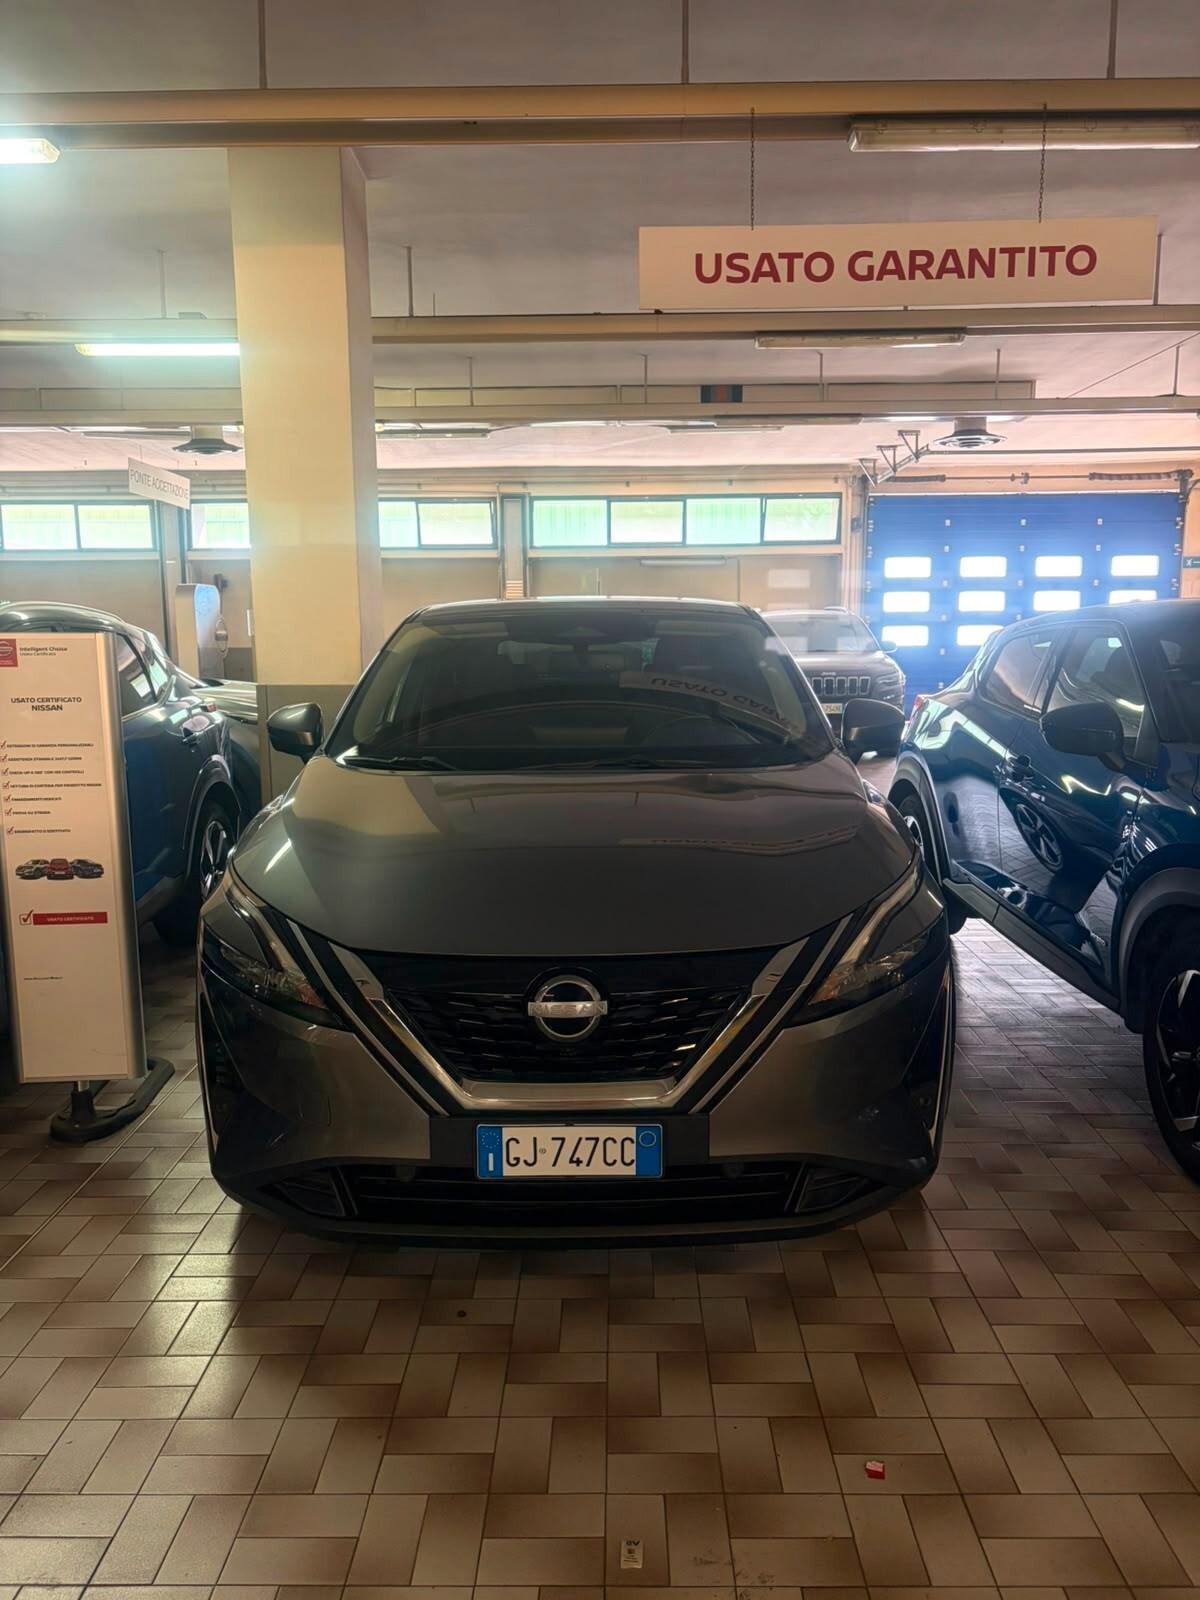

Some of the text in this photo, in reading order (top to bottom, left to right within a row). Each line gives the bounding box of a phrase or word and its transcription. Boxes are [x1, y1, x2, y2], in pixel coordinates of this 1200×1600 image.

[695, 244, 1098, 285] USATO GARANTITO
[129, 468, 152, 488] PONTE
[31, 704, 63, 712] NISSAN
[505, 1136, 636, 1168] GJ 747CC
